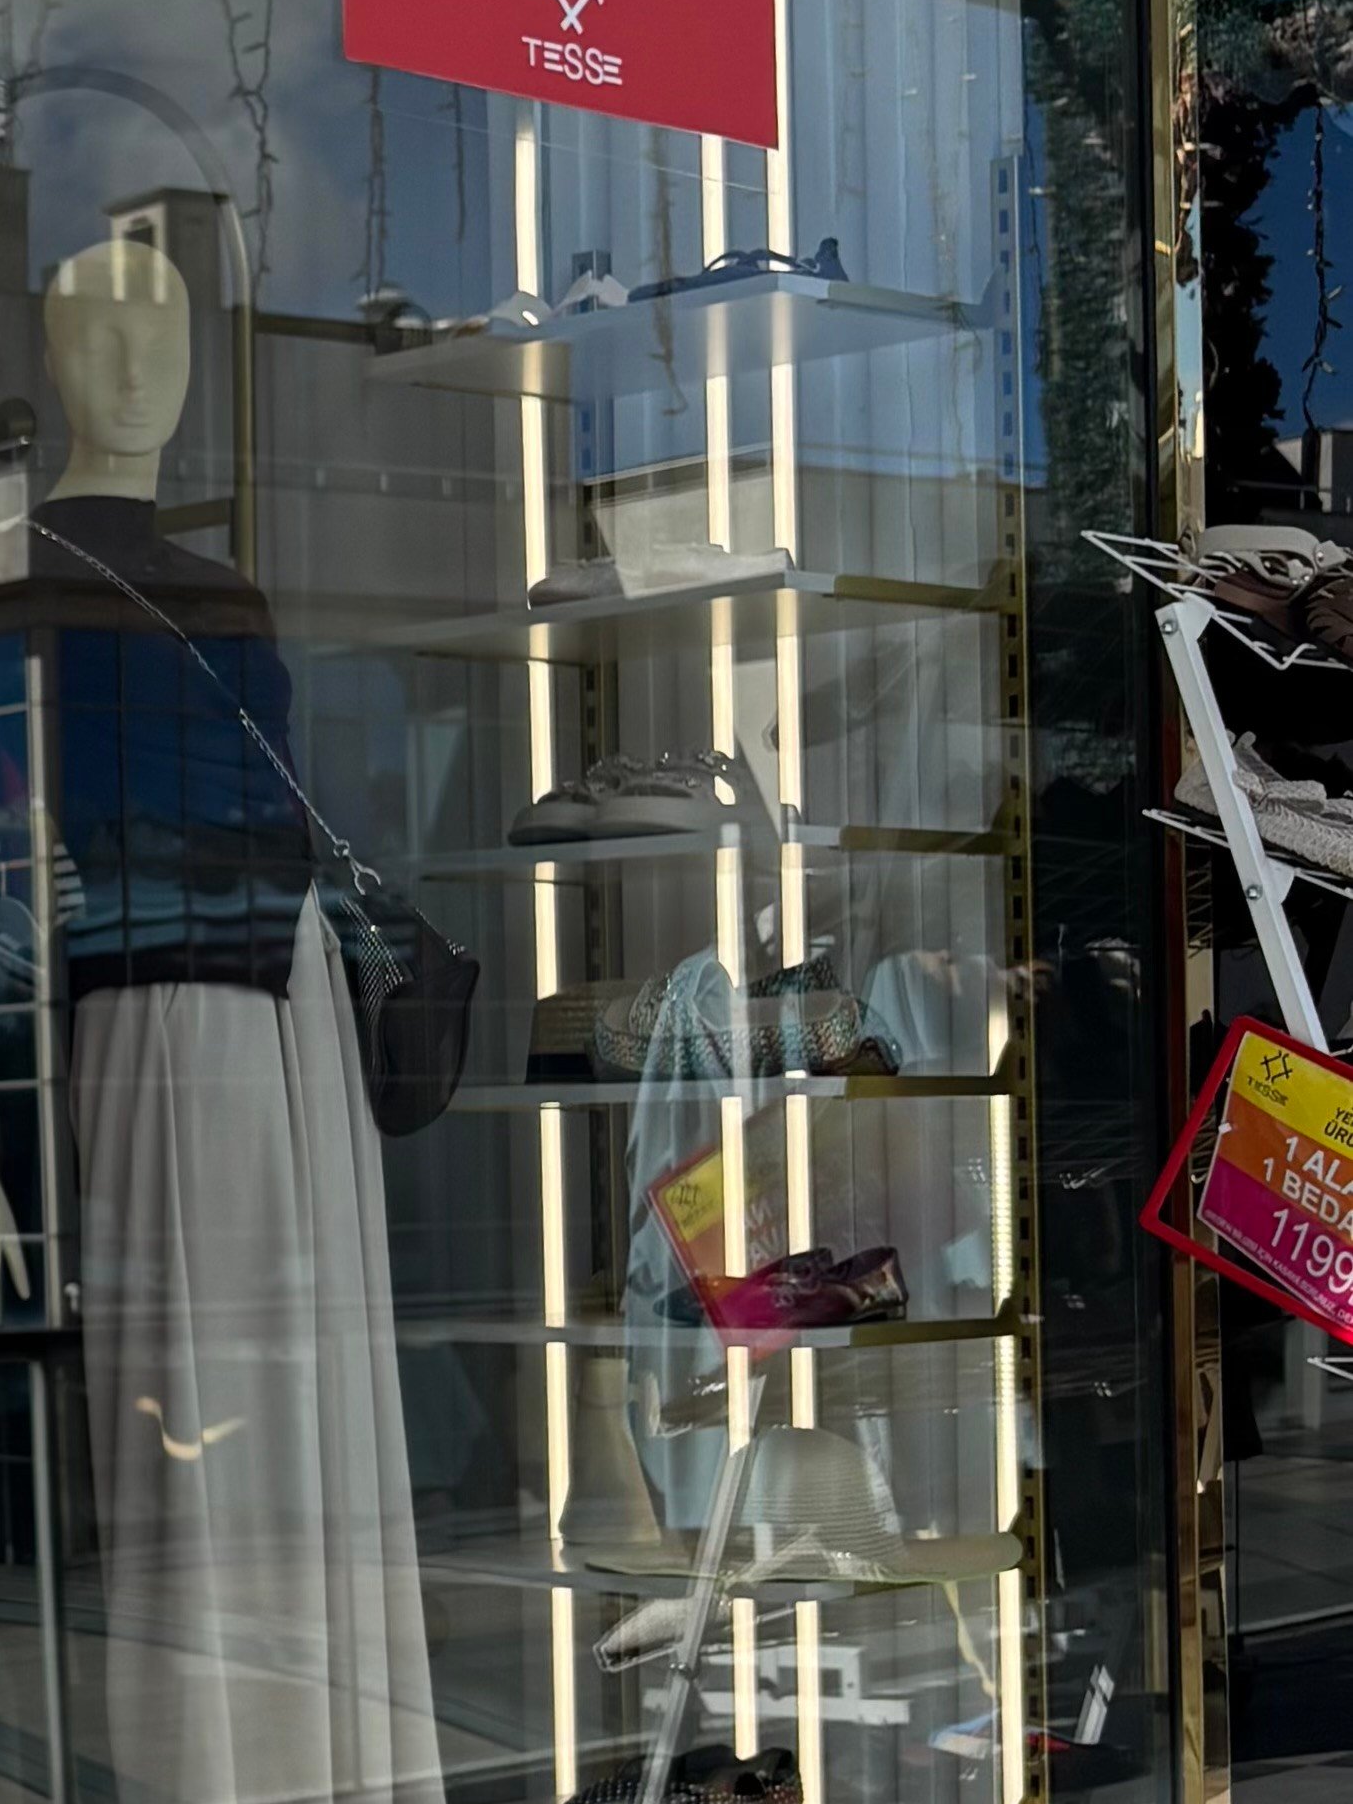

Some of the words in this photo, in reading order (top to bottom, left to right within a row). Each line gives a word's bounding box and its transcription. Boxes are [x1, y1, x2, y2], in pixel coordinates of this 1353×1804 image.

[521, 36, 623, 86] TESSE
[1285, 1136, 1299, 1163] 1
[1262, 1158, 1275, 1183] 1
[1282, 1168, 1353, 1241] BEDA
